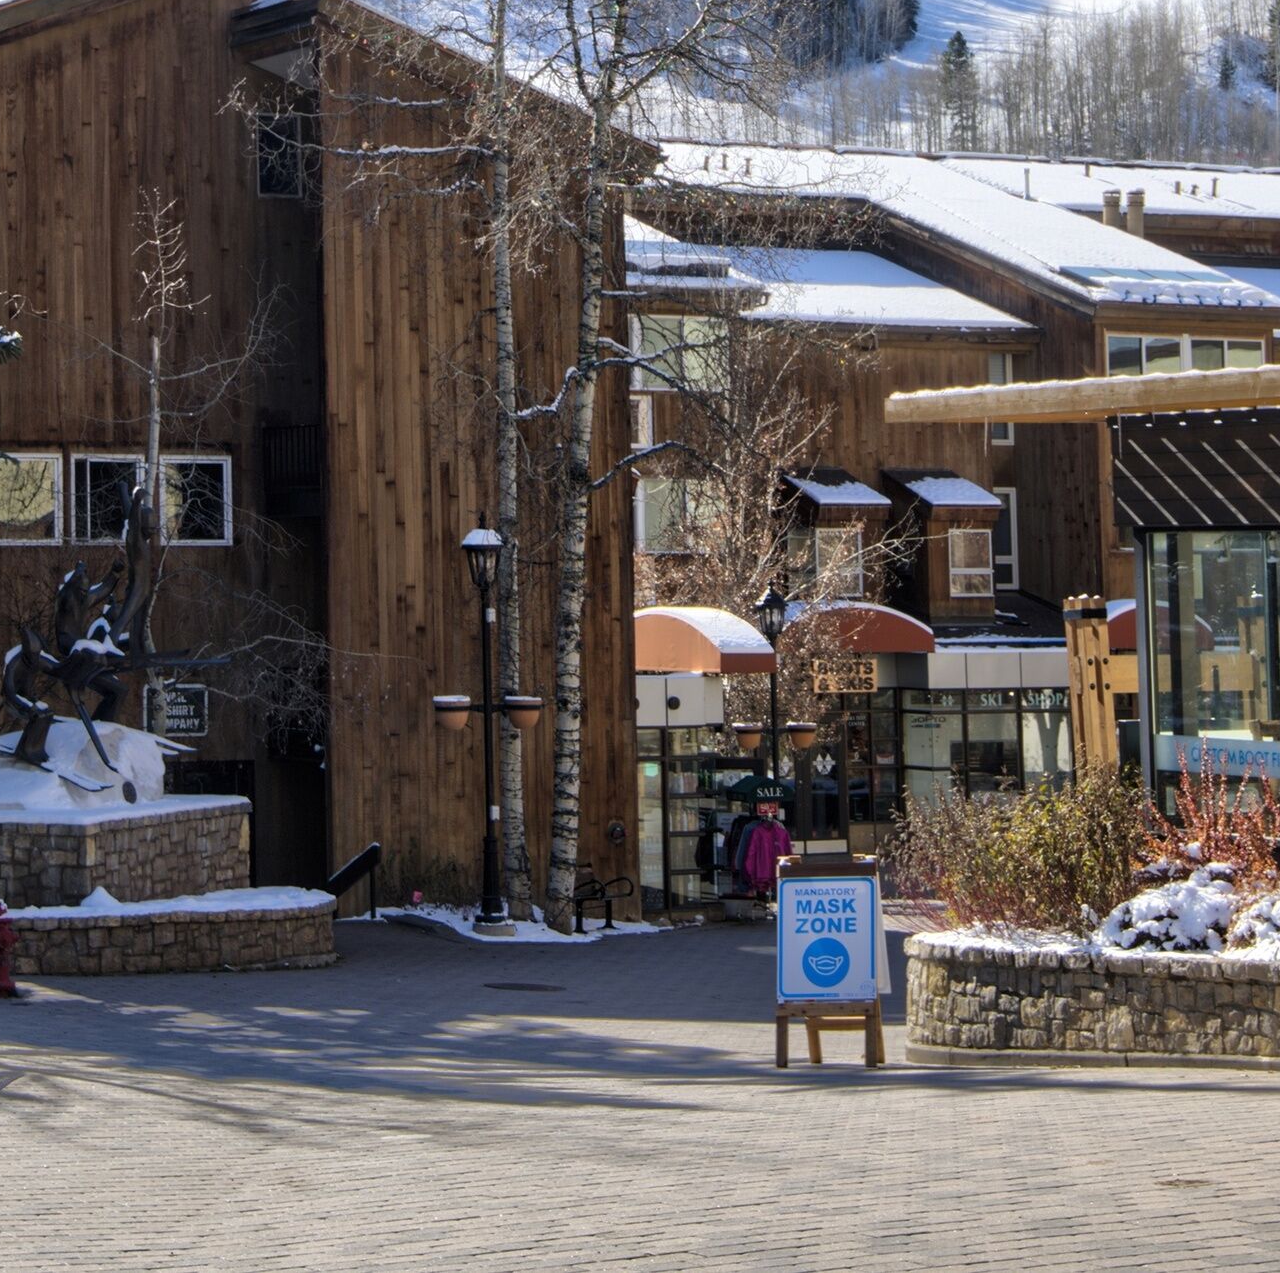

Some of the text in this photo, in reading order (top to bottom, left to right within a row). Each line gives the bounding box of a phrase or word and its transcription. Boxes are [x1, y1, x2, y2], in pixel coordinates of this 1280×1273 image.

[980, 693, 1064, 707] SKI SHOP
[756, 787, 784, 797] SALE
[795, 888, 856, 896] MANDATORY
[796, 898, 857, 914] MASK
[795, 917, 857, 934] ZONE
